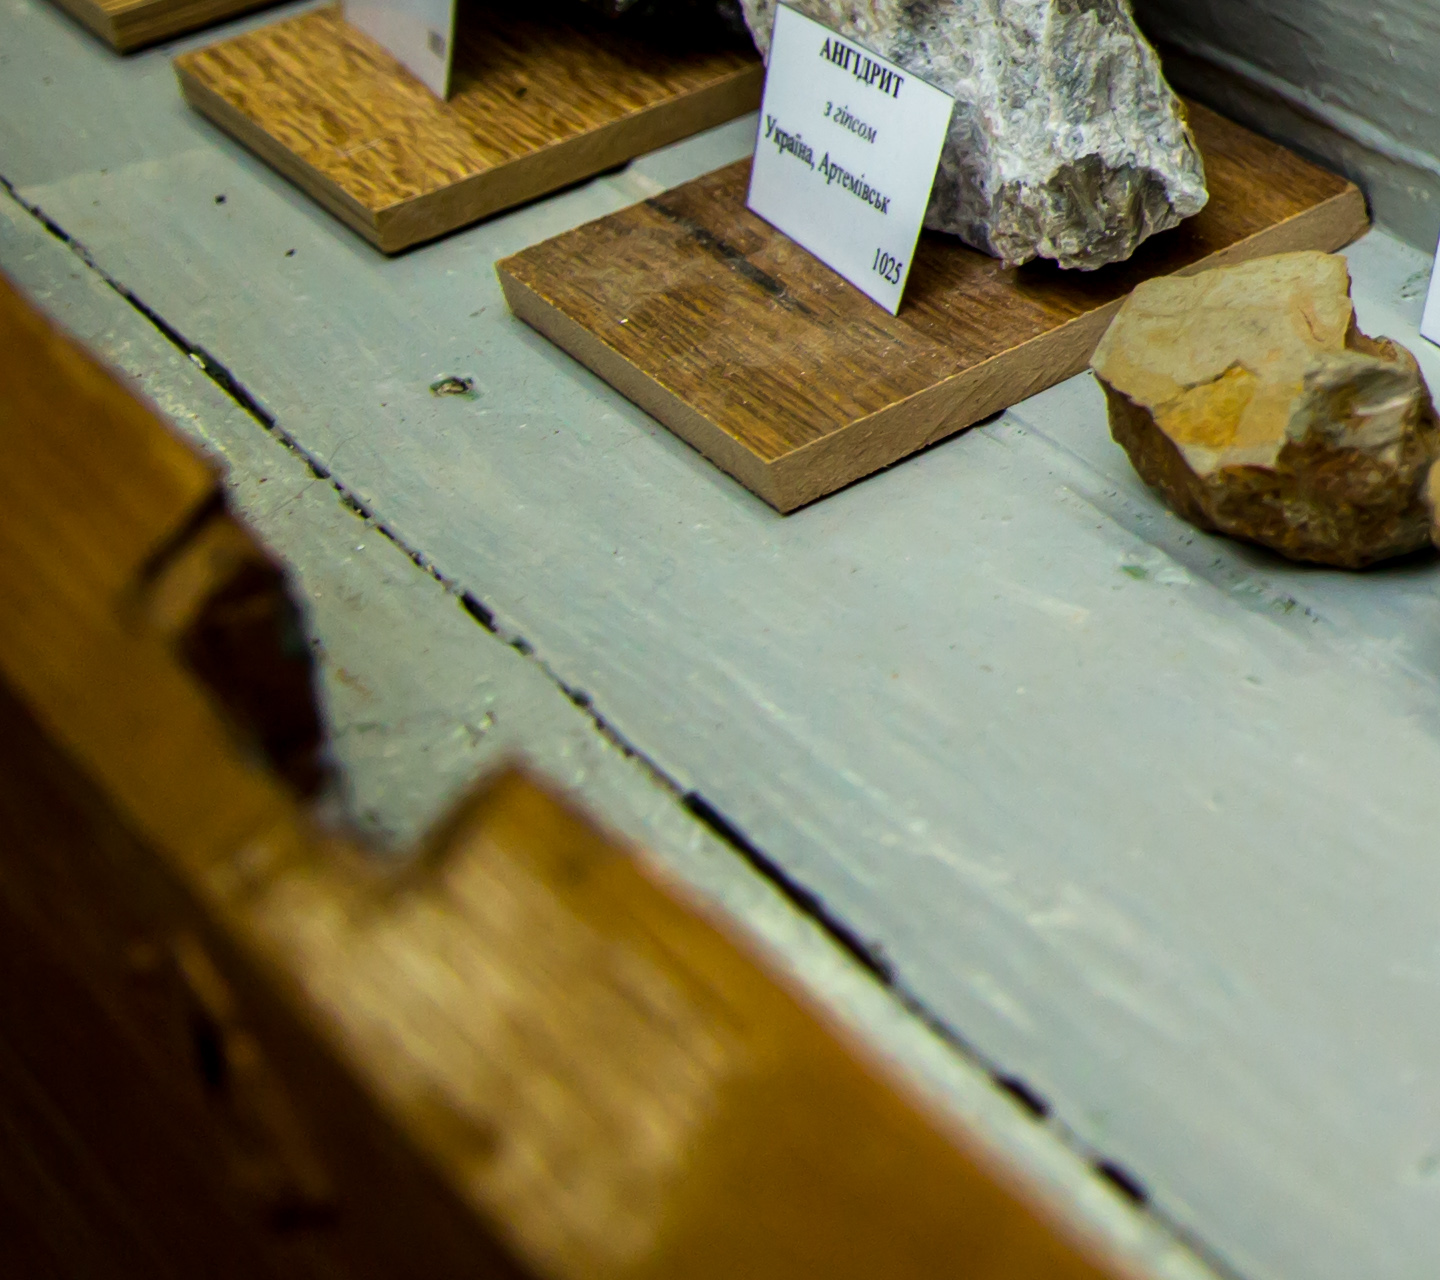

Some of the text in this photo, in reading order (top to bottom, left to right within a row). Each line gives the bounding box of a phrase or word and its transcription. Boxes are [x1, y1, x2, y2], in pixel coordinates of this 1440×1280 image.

[819, 37, 904, 99] АНГІДРИТ
[823, 101, 878, 144] з гіпсом
[765, 113, 891, 215] Україна, Артемівськ
[872, 247, 903, 286] 1025
